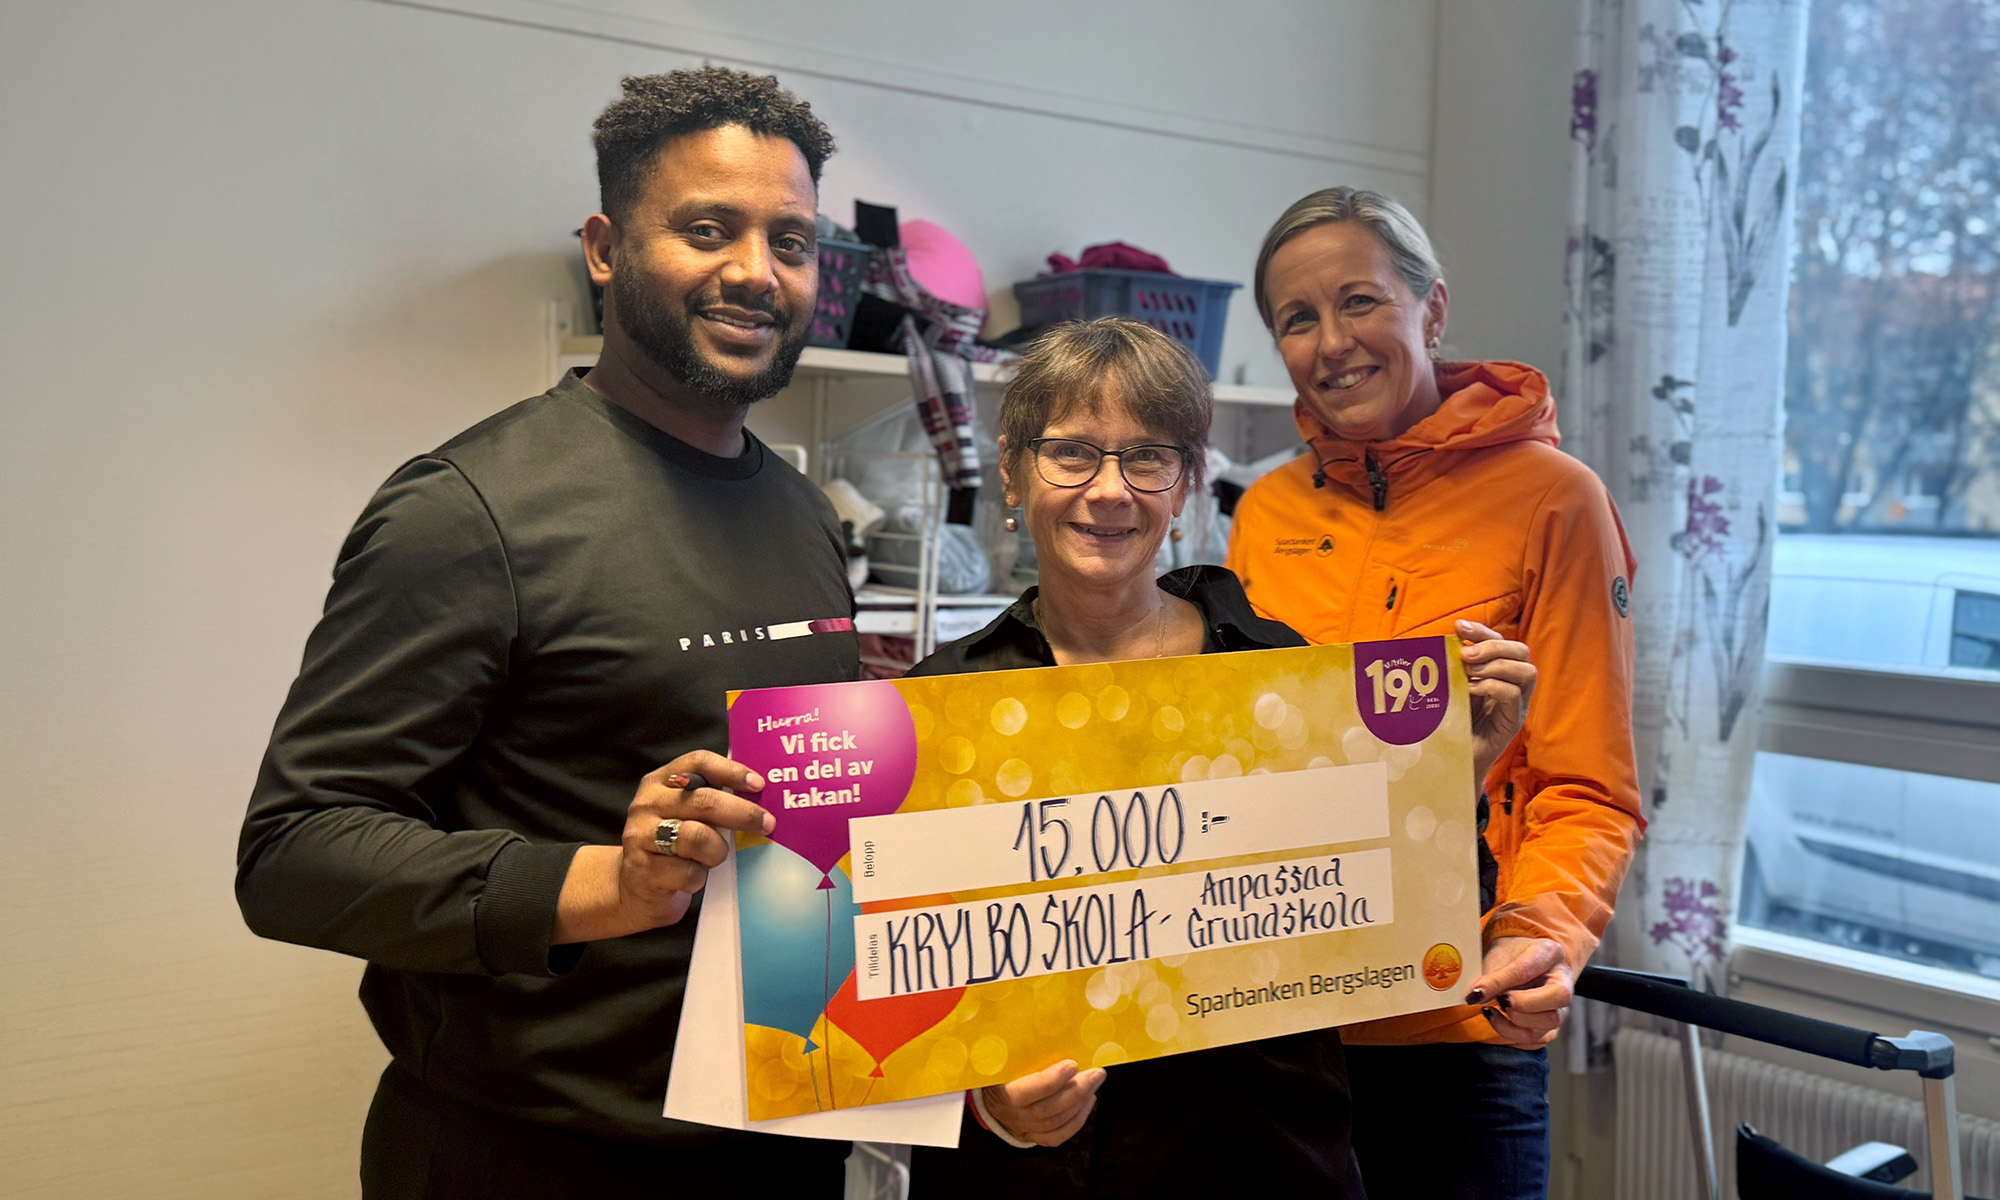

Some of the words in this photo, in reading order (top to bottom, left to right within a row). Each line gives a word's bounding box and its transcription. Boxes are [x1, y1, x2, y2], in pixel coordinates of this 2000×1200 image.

[678, 627, 766, 651] PARIS
[1364, 656, 1439, 714] 190
[757, 708, 820, 733] Hurra!
[780, 734, 805, 754] Vi
[811, 730, 858, 752] fick
[767, 764, 798, 783] en
[804, 759, 842, 780] del
[847, 758, 874, 777] av
[783, 784, 861, 809] kakan!
[863, 840, 876, 878] Belopp
[1199, 857, 1345, 912] Anpassad
[1187, 891, 1375, 949] Grundskola
[868, 933, 880, 979] Tilldelas
[886, 902, 1032, 995] KRYLBO
[1186, 981, 1305, 1018] Sparbanken
[1309, 963, 1416, 995] Bergslagen
